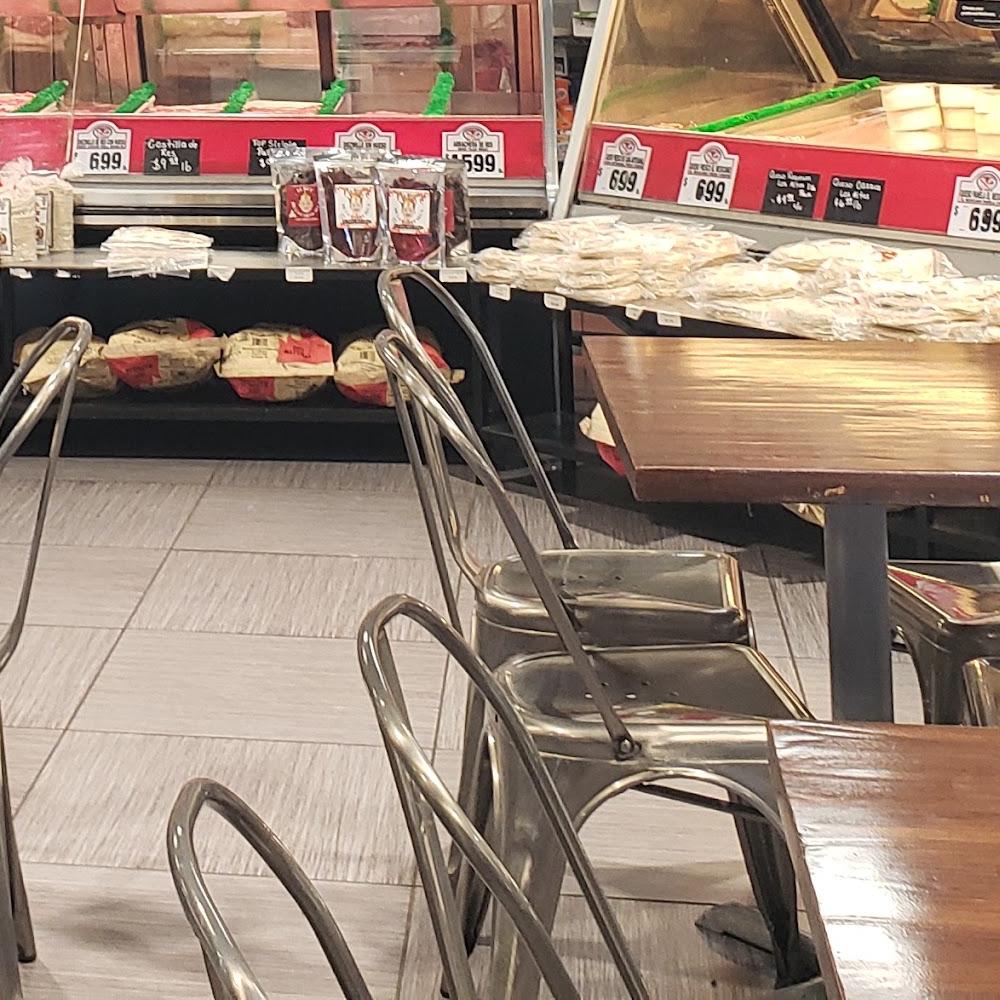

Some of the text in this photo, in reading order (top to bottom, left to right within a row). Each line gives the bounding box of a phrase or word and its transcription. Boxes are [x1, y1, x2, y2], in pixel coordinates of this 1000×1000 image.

[89, 152, 122, 171] 699
[608, 169, 638, 193] 699
[695, 178, 726, 203] 699
[969, 207, 1000, 232] 699
